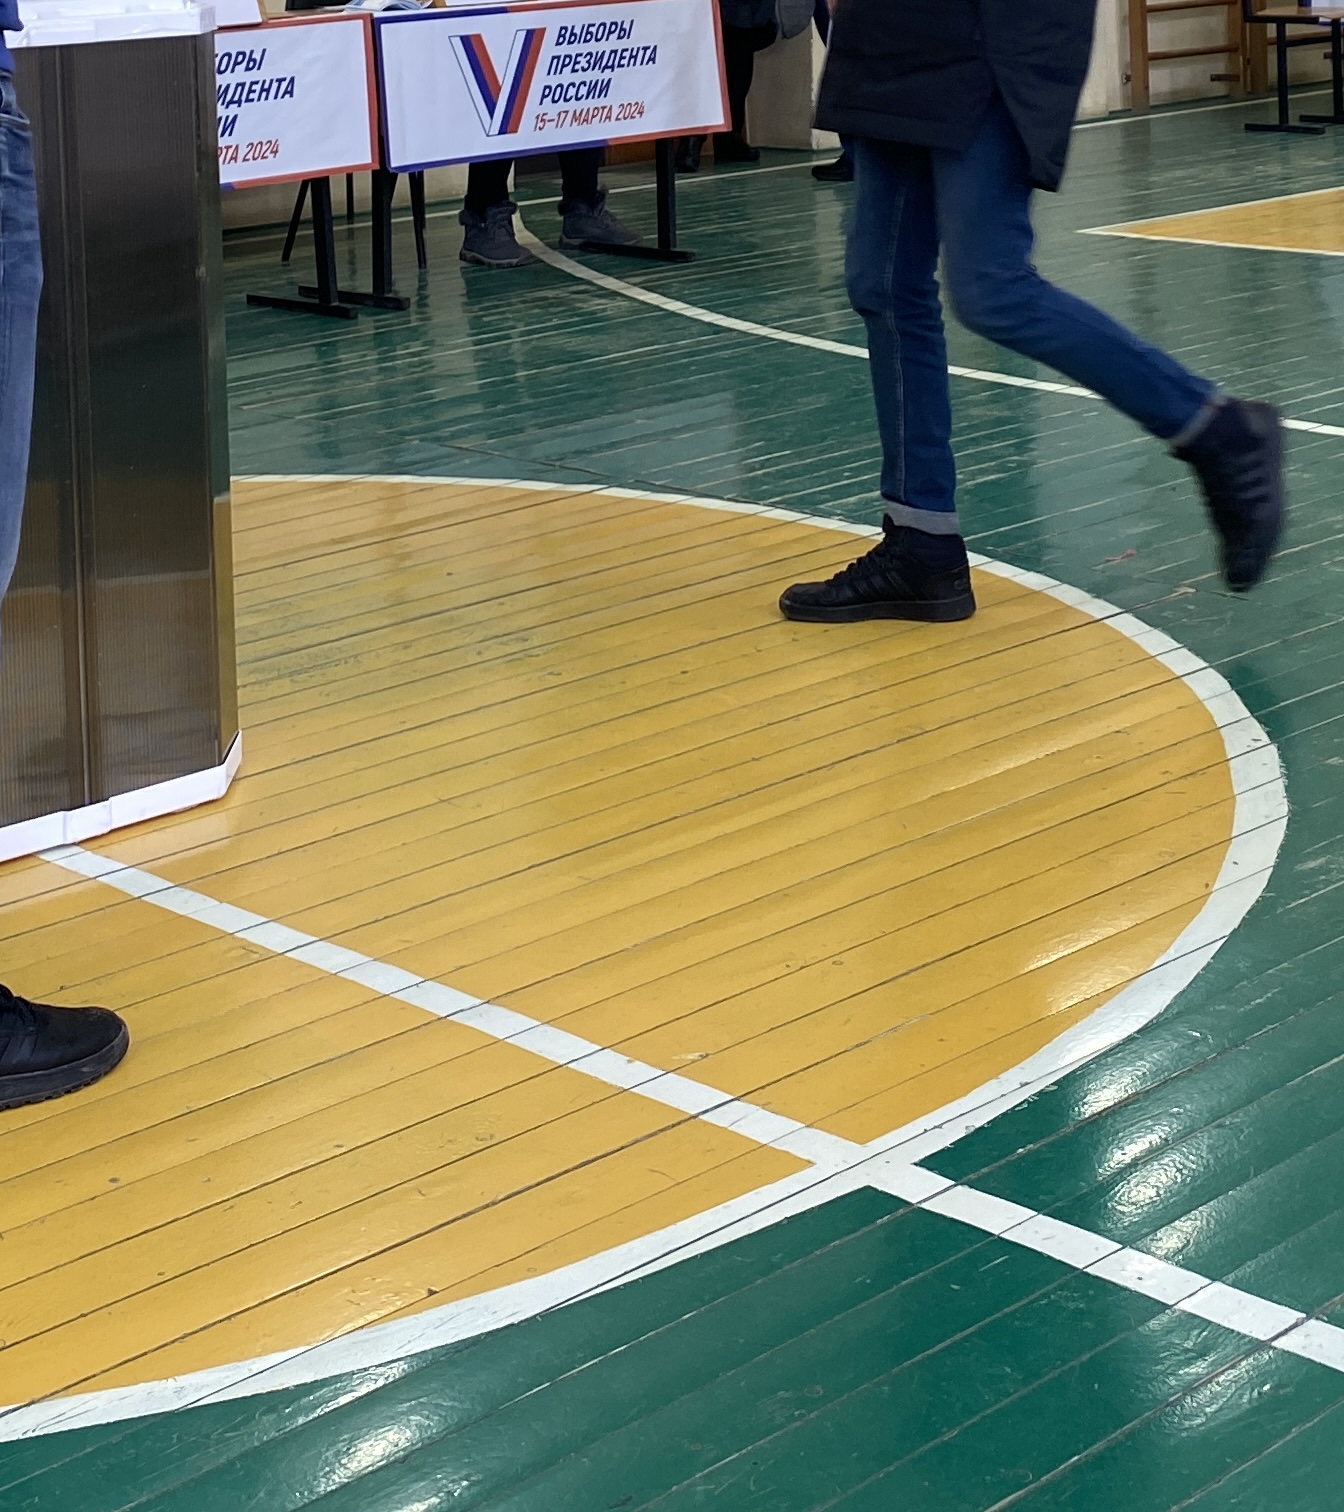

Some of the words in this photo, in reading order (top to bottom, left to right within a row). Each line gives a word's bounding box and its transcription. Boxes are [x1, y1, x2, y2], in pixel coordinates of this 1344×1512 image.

[555, 19, 634, 47] ВЫБОРЫ
[215, 48, 267, 75] ОРЫ
[546, 45, 658, 76] ПРЕЗИДЕНТА
[217, 76, 296, 109] ИДЕНТА
[539, 78, 612, 106] РОССИИ
[570, 104, 613, 127] МАРТА
[615, 101, 645, 122] 2024
[242, 138, 280, 163] 2024
